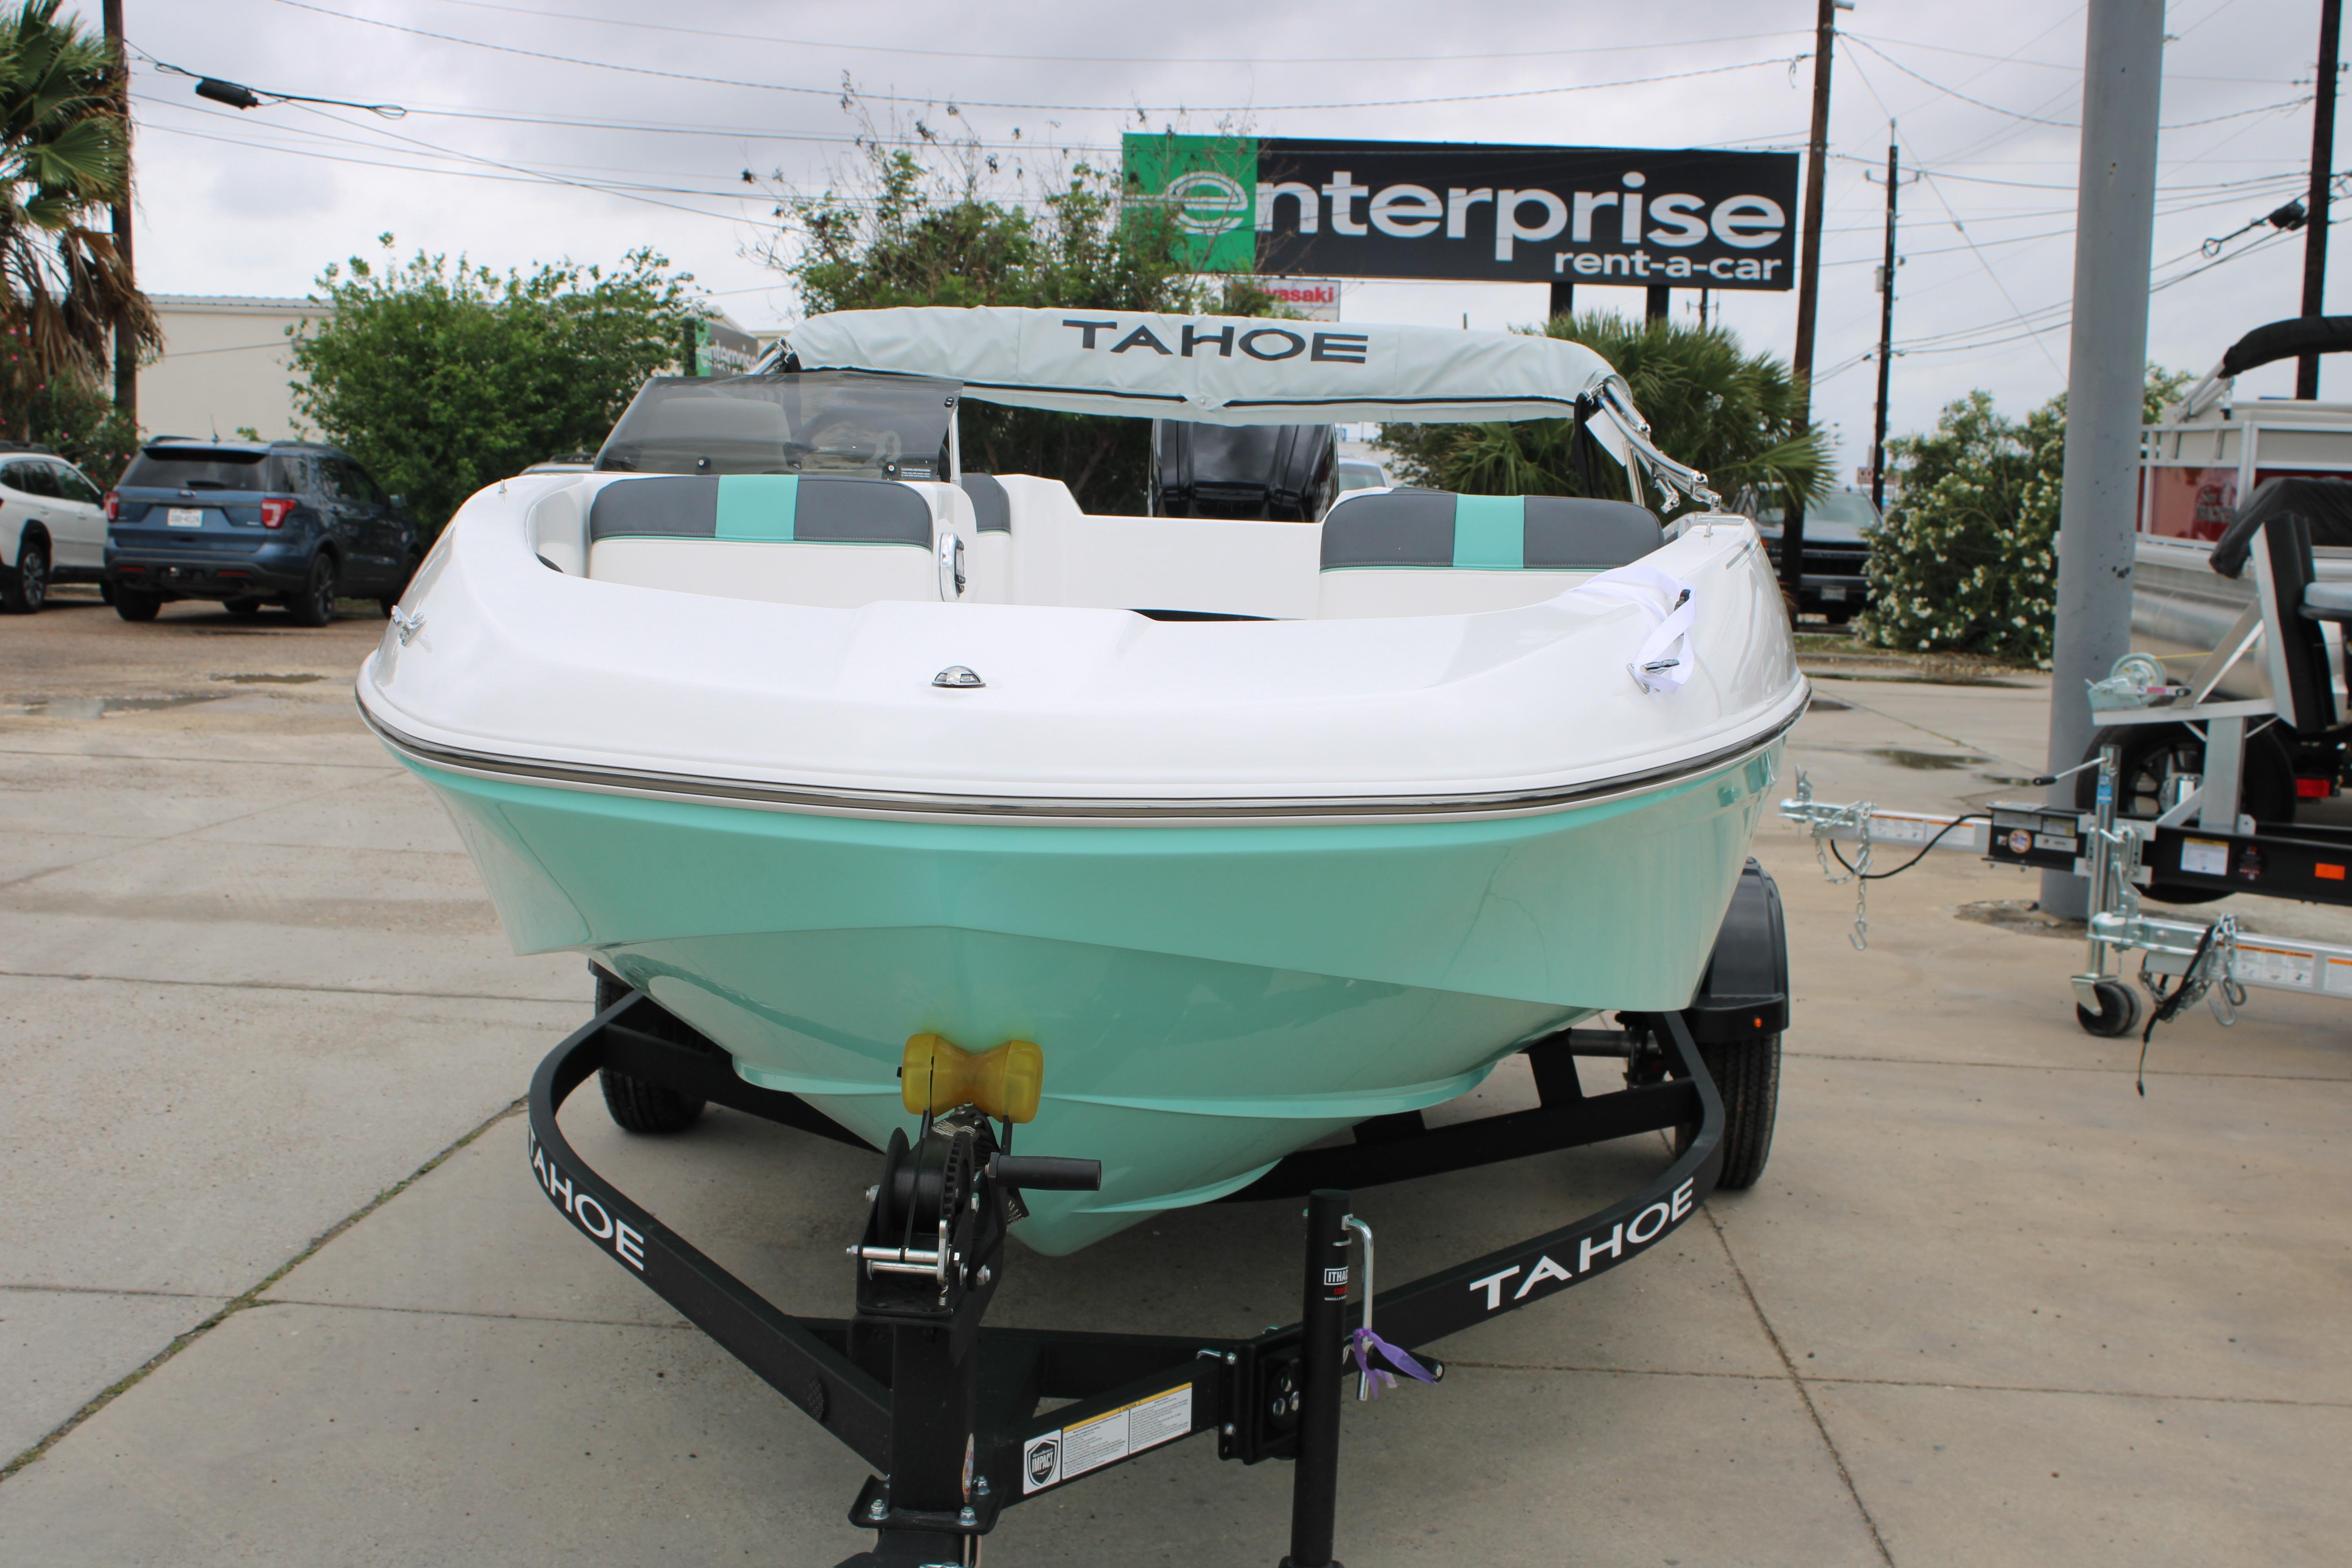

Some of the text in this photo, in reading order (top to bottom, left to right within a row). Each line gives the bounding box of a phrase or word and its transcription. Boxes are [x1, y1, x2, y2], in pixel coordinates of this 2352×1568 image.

[1160, 170, 1786, 261] enterprise
[1554, 250, 1782, 280] rent-a-car
[1062, 319, 1369, 364] TAHOE
[529, 1123, 644, 1271] TAHOE
[1469, 1176, 1694, 1310] TAHOE
[1032, 1452, 1054, 1473] IMPACT
